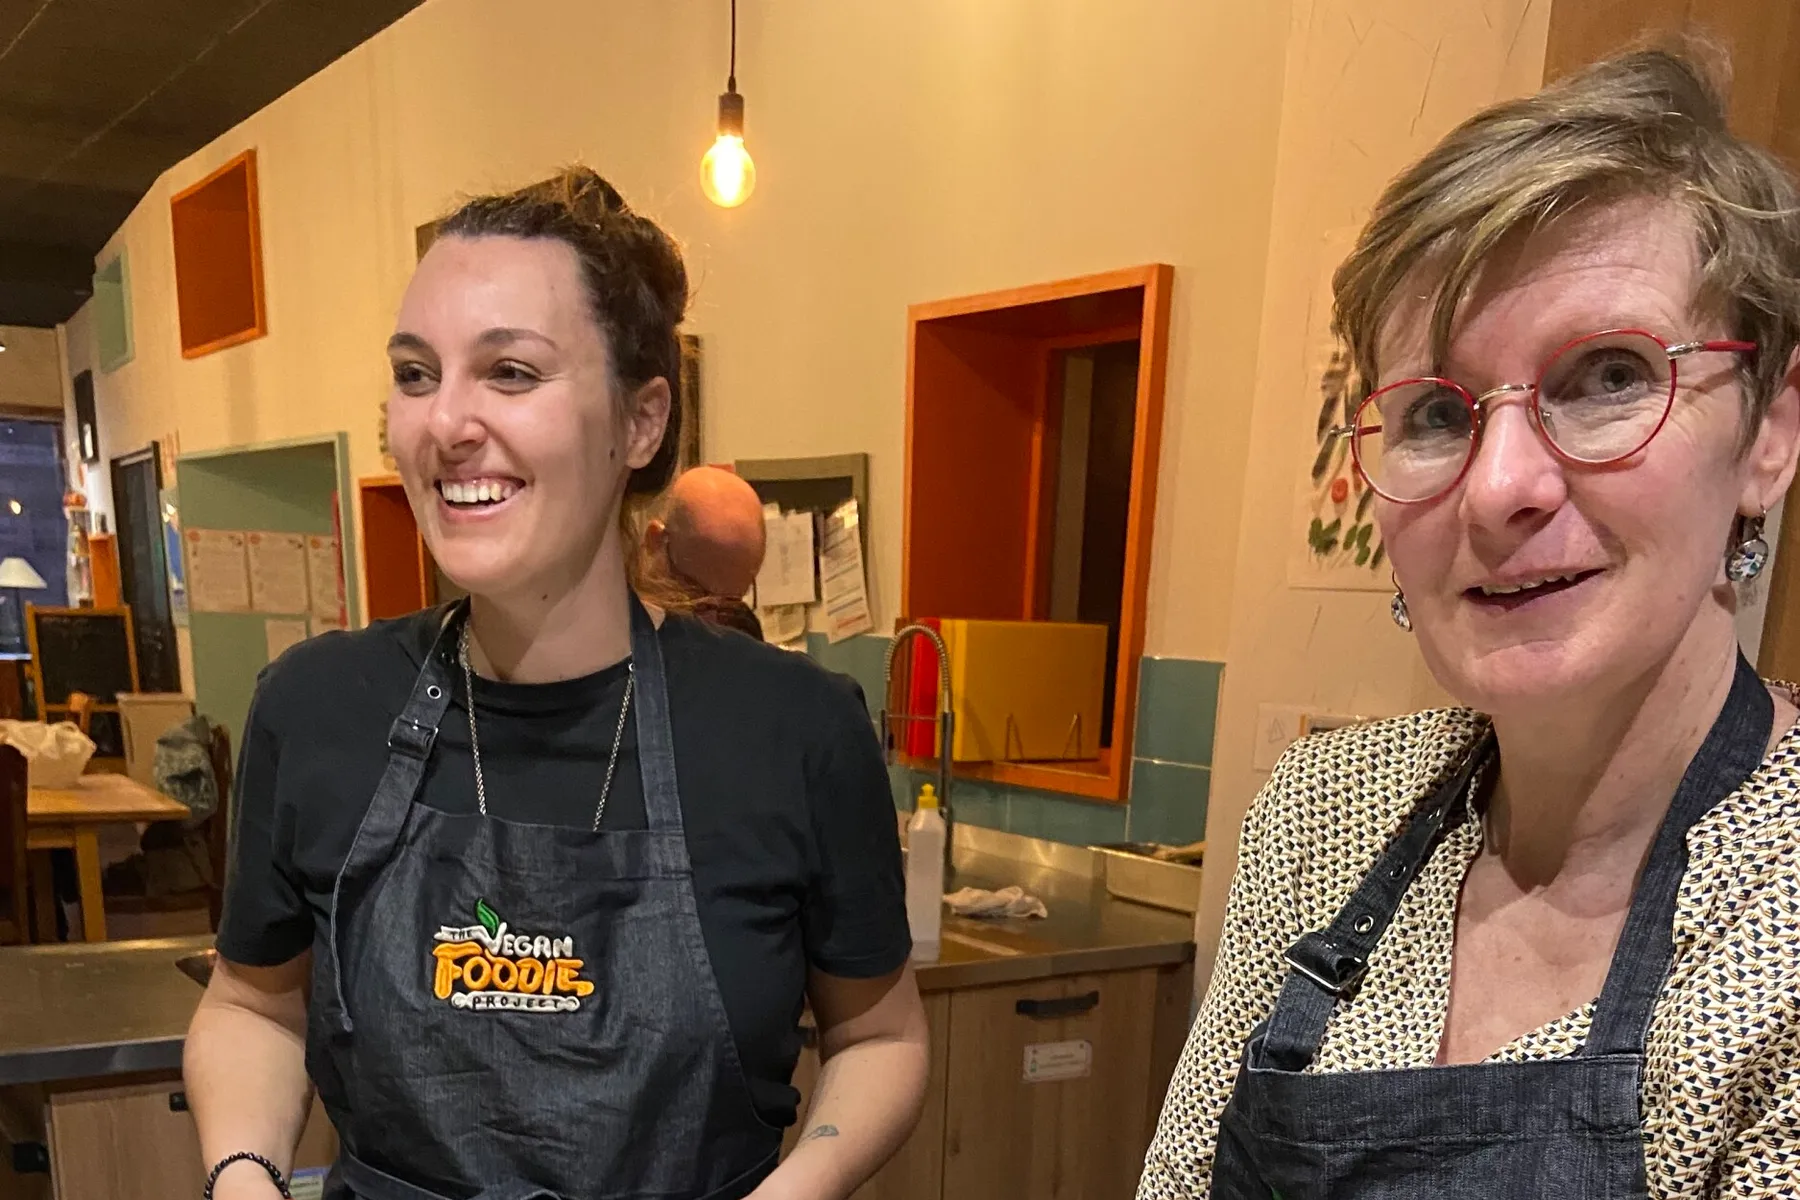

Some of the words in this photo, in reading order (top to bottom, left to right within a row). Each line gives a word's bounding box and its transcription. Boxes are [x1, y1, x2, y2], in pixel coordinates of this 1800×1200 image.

[450, 929, 472, 941] THE
[476, 922, 573, 958] VEGAN
[432, 941, 595, 999] FOODIE
[472, 994, 560, 1009] PROJECT
